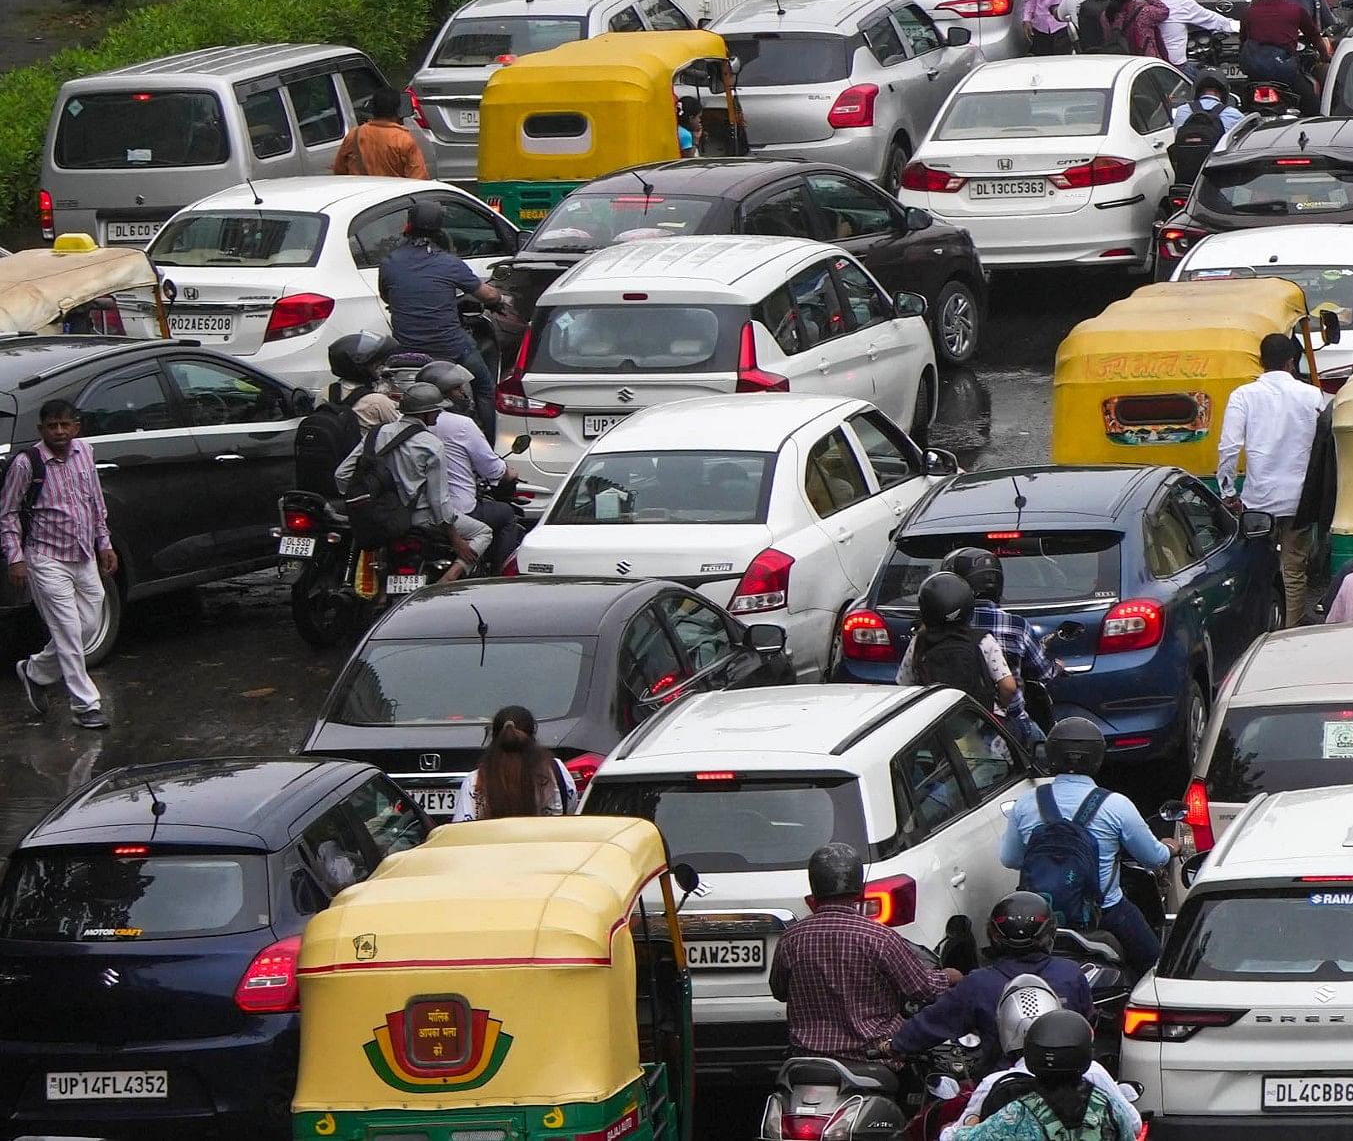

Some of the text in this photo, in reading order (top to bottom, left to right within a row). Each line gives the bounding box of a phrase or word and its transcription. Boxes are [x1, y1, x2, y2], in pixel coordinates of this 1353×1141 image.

[466, 111, 479, 124] DL
[976, 181, 1045, 196] DL13CC5363
[168, 316, 232, 334] R02AE6208
[593, 420, 616, 435] UP
[284, 547, 311, 555] F1625
[702, 564, 732, 572] TOUR
[412, 793, 456, 810] 4EY3
[83, 928, 144, 937] MOTORCRAFT
[684, 944, 762, 965] CAW2538
[418, 1026, 441, 1039] आपका
[58, 1075, 166, 1096] UP14FL4352
